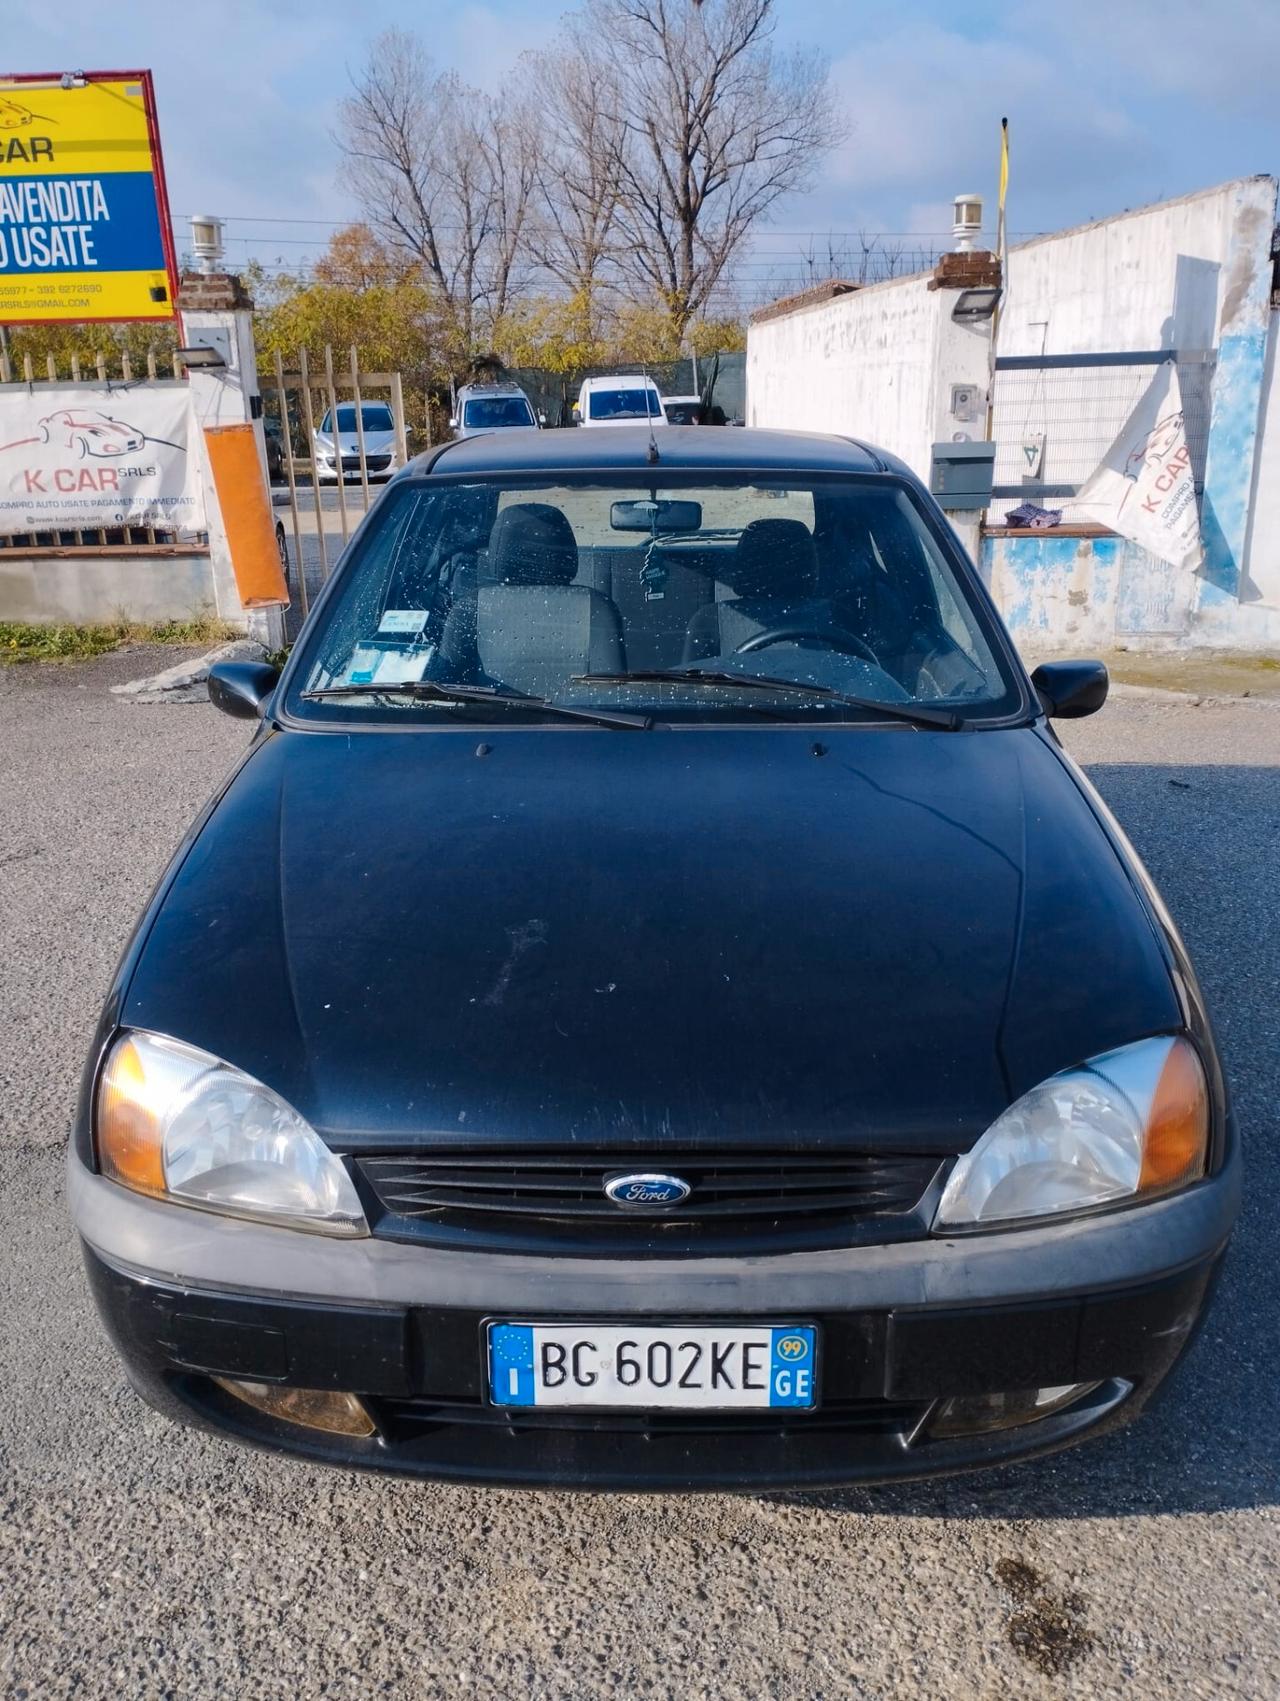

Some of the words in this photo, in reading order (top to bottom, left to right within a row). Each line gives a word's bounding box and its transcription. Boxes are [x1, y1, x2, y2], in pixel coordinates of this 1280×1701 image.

[0, 137, 54, 163] AR
[10, 225, 97, 267] USATE
[24, 470, 47, 493] K
[54, 468, 119, 492] CAR
[118, 466, 156, 477] SRLS
[36, 500, 59, 508] AUTO
[61, 499, 89, 508] USATE
[1141, 493, 1162, 513] K
[1161, 482, 1190, 519] COMPRO
[626, 1184, 670, 1200] Ford
[783, 1341, 801, 1356] 99
[541, 1342, 598, 1387] BG
[616, 1341, 768, 1389] 602KE
[509, 1368, 518, 1395] I
[775, 1369, 809, 1397] GE
